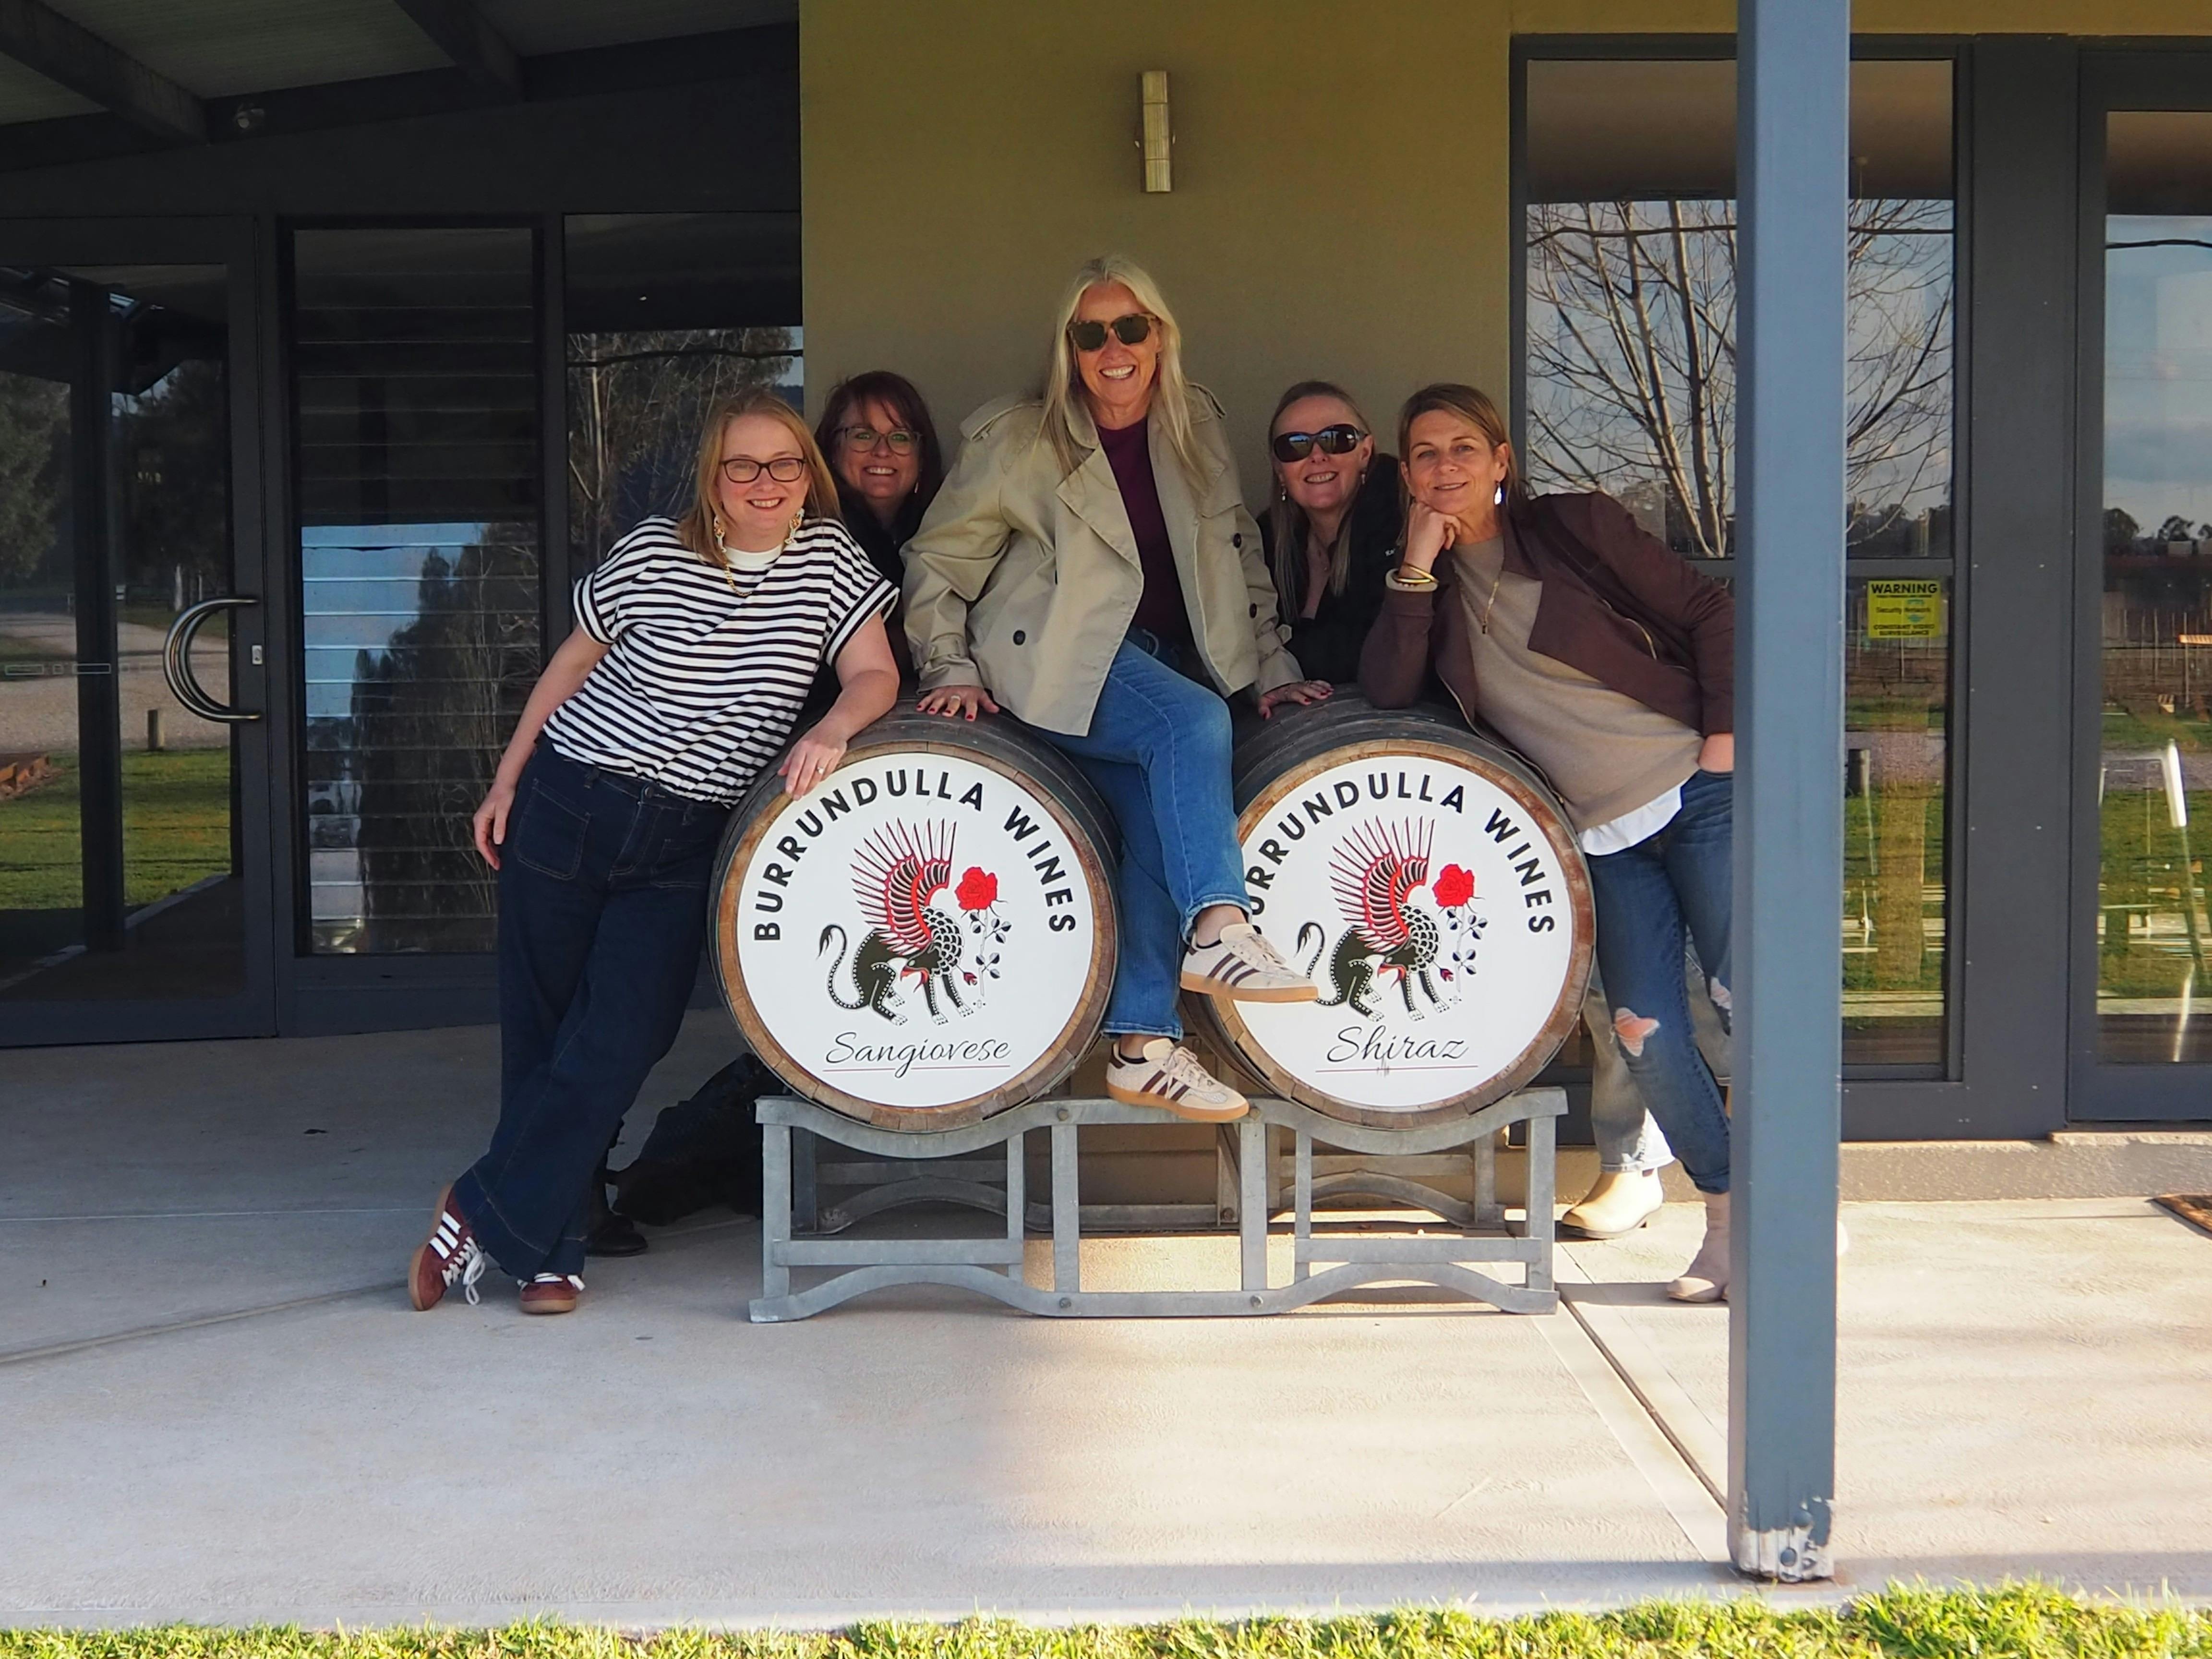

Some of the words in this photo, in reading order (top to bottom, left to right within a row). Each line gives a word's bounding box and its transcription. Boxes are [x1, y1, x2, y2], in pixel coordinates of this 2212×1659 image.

[1872, 583, 1938, 594] WARNING
[754, 768, 983, 941] BURRUNDULLA
[1003, 805, 1076, 932] WINES
[1244, 771, 1464, 935] URRUNDULLA
[1484, 807, 1555, 933] WINES
[825, 1031, 1011, 1079] Sangiovese
[1326, 1024, 1469, 1063] Shiraz
